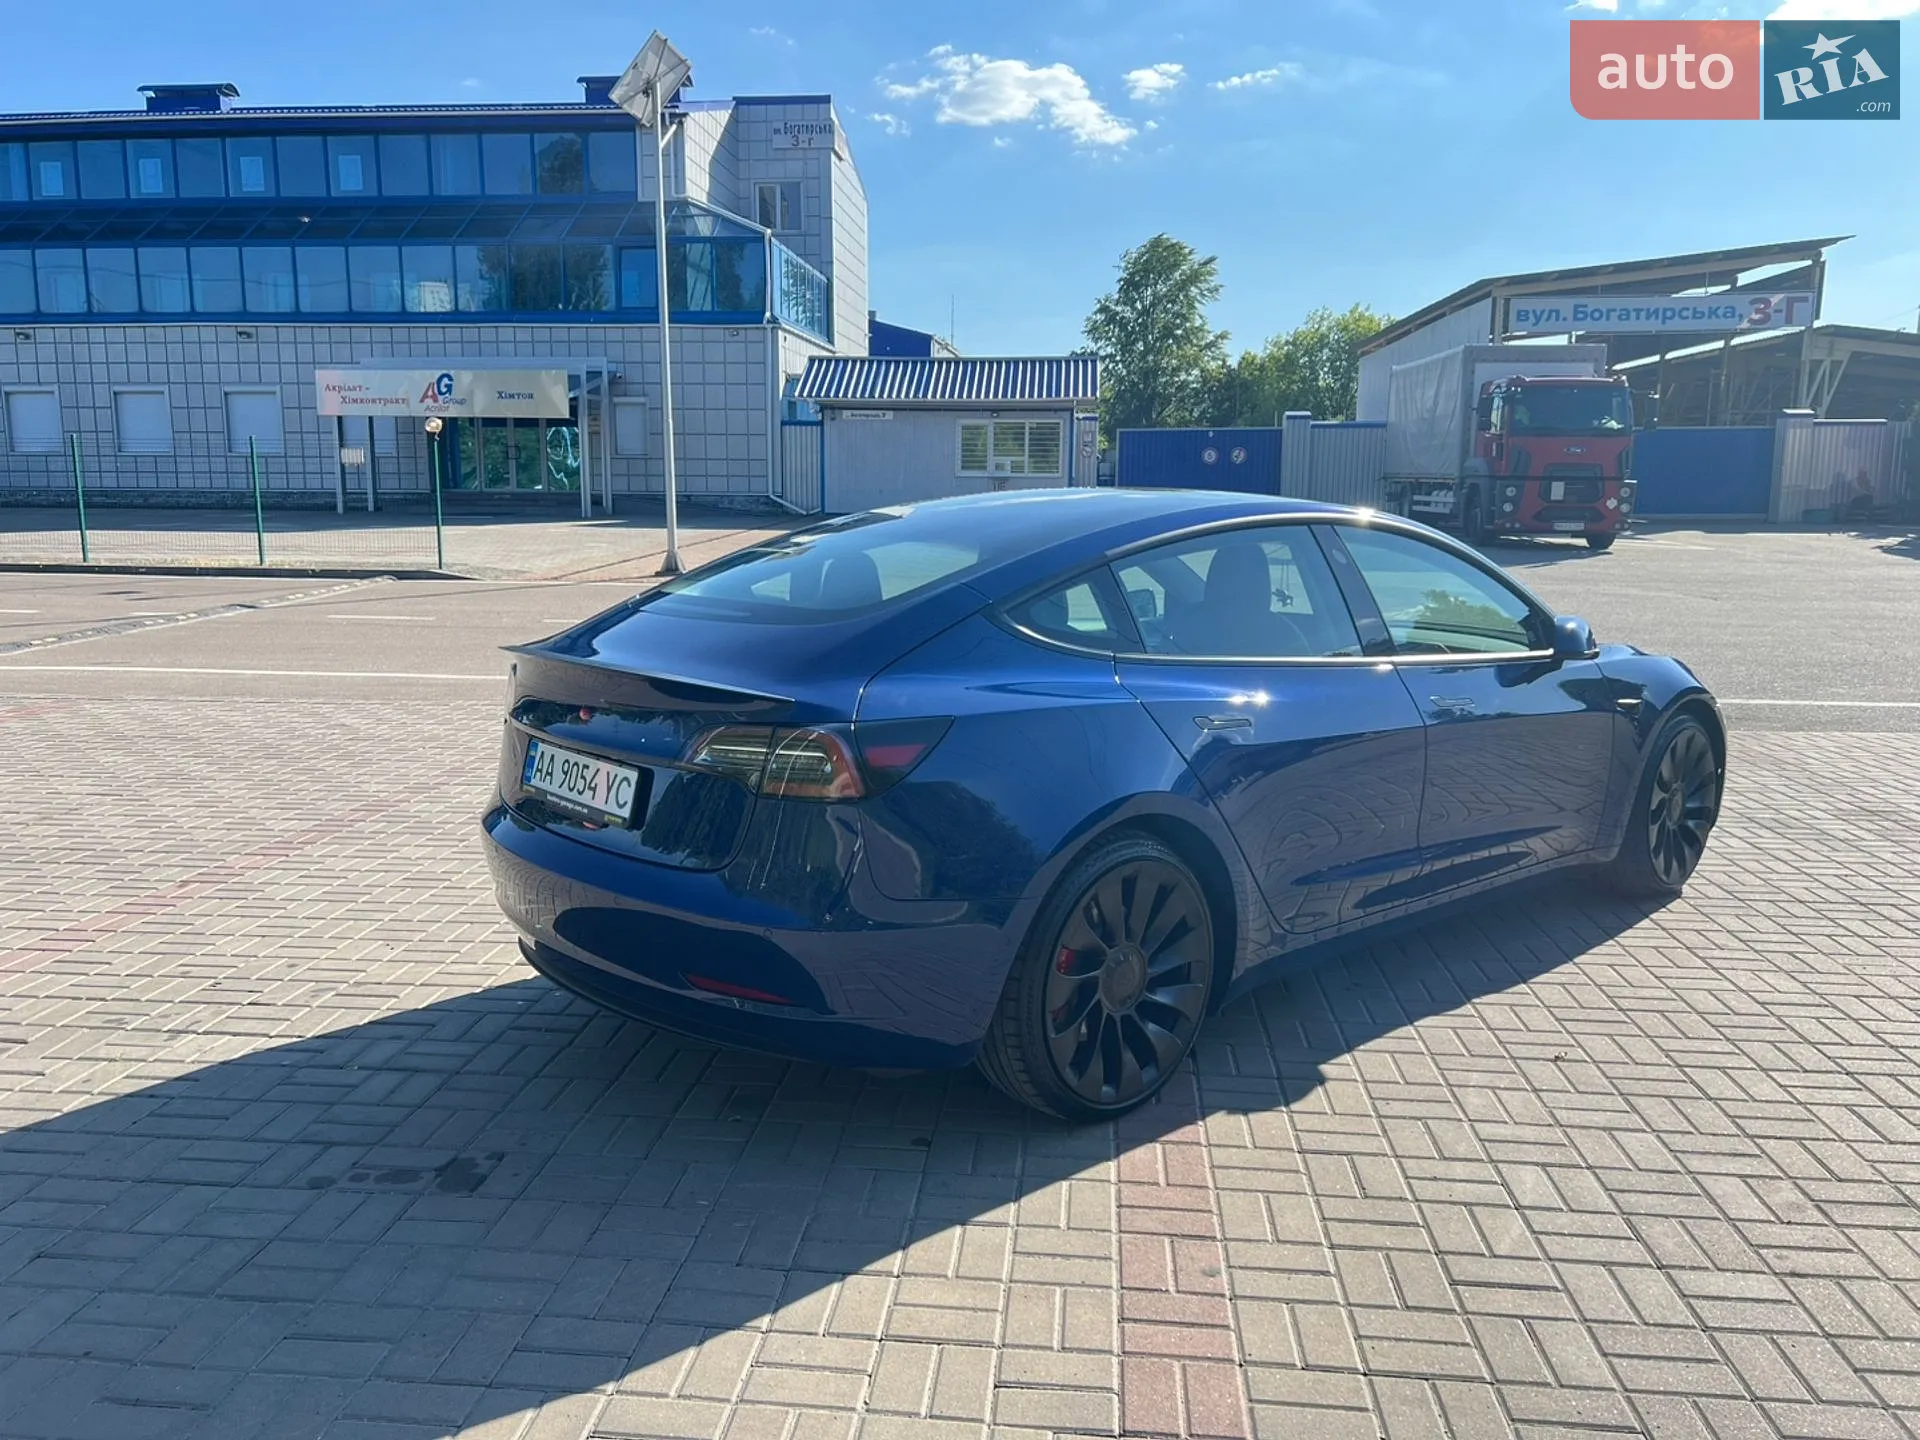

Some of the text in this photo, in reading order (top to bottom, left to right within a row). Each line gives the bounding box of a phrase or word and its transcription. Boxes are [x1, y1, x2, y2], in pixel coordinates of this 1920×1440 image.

[1516, 308, 1567, 327] вул.
[1572, 303, 1744, 325] Богатирська,
[324, 383, 362, 394] Акрілат
[340, 395, 407, 406] Хімконтракт
[497, 390, 534, 400] Хімтон
[442, 396, 468, 406] Group
[533, 751, 555, 787] AA
[558, 759, 601, 800] 9054
[605, 771, 631, 809] YC
